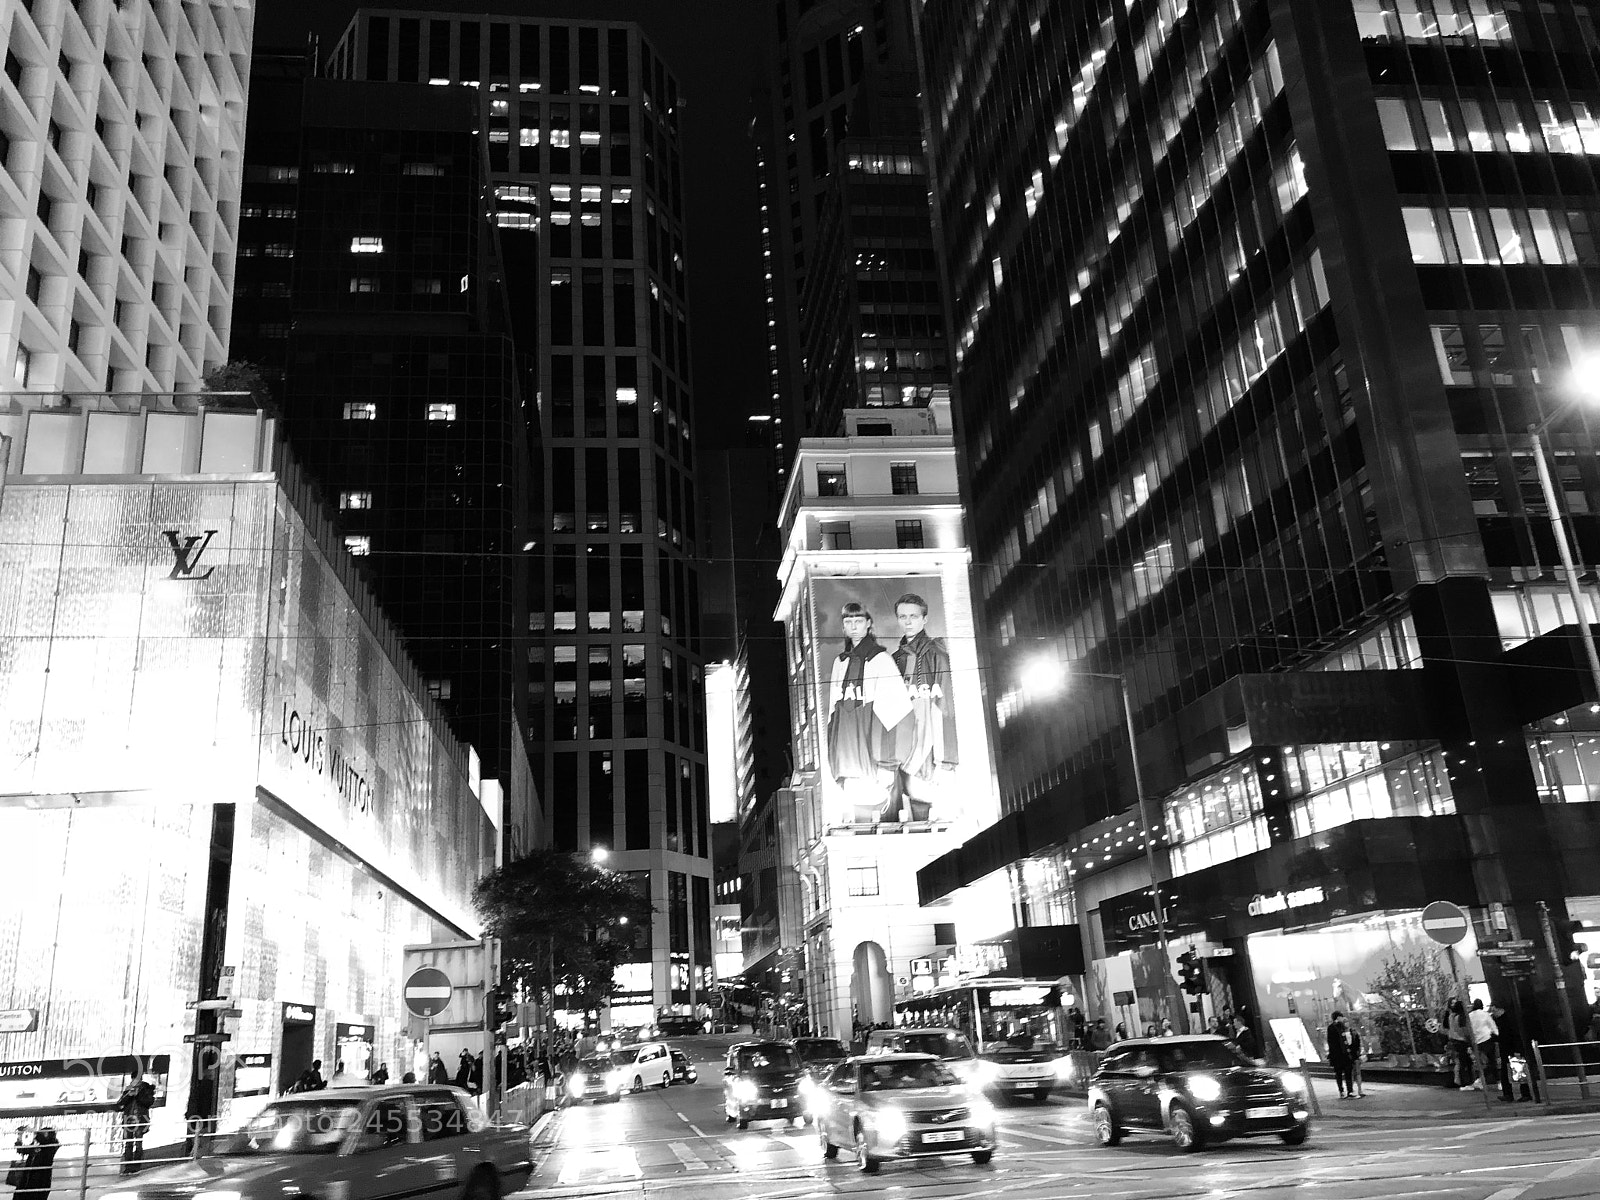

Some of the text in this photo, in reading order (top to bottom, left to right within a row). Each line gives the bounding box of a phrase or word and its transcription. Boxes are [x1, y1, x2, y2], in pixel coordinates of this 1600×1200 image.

[831, 683, 944, 700] ALAGA
[281, 702, 375, 817] LOUIS VUITTON
[1128, 907, 1168, 931] CANAI
[0, 1065, 42, 1077] UITTON
